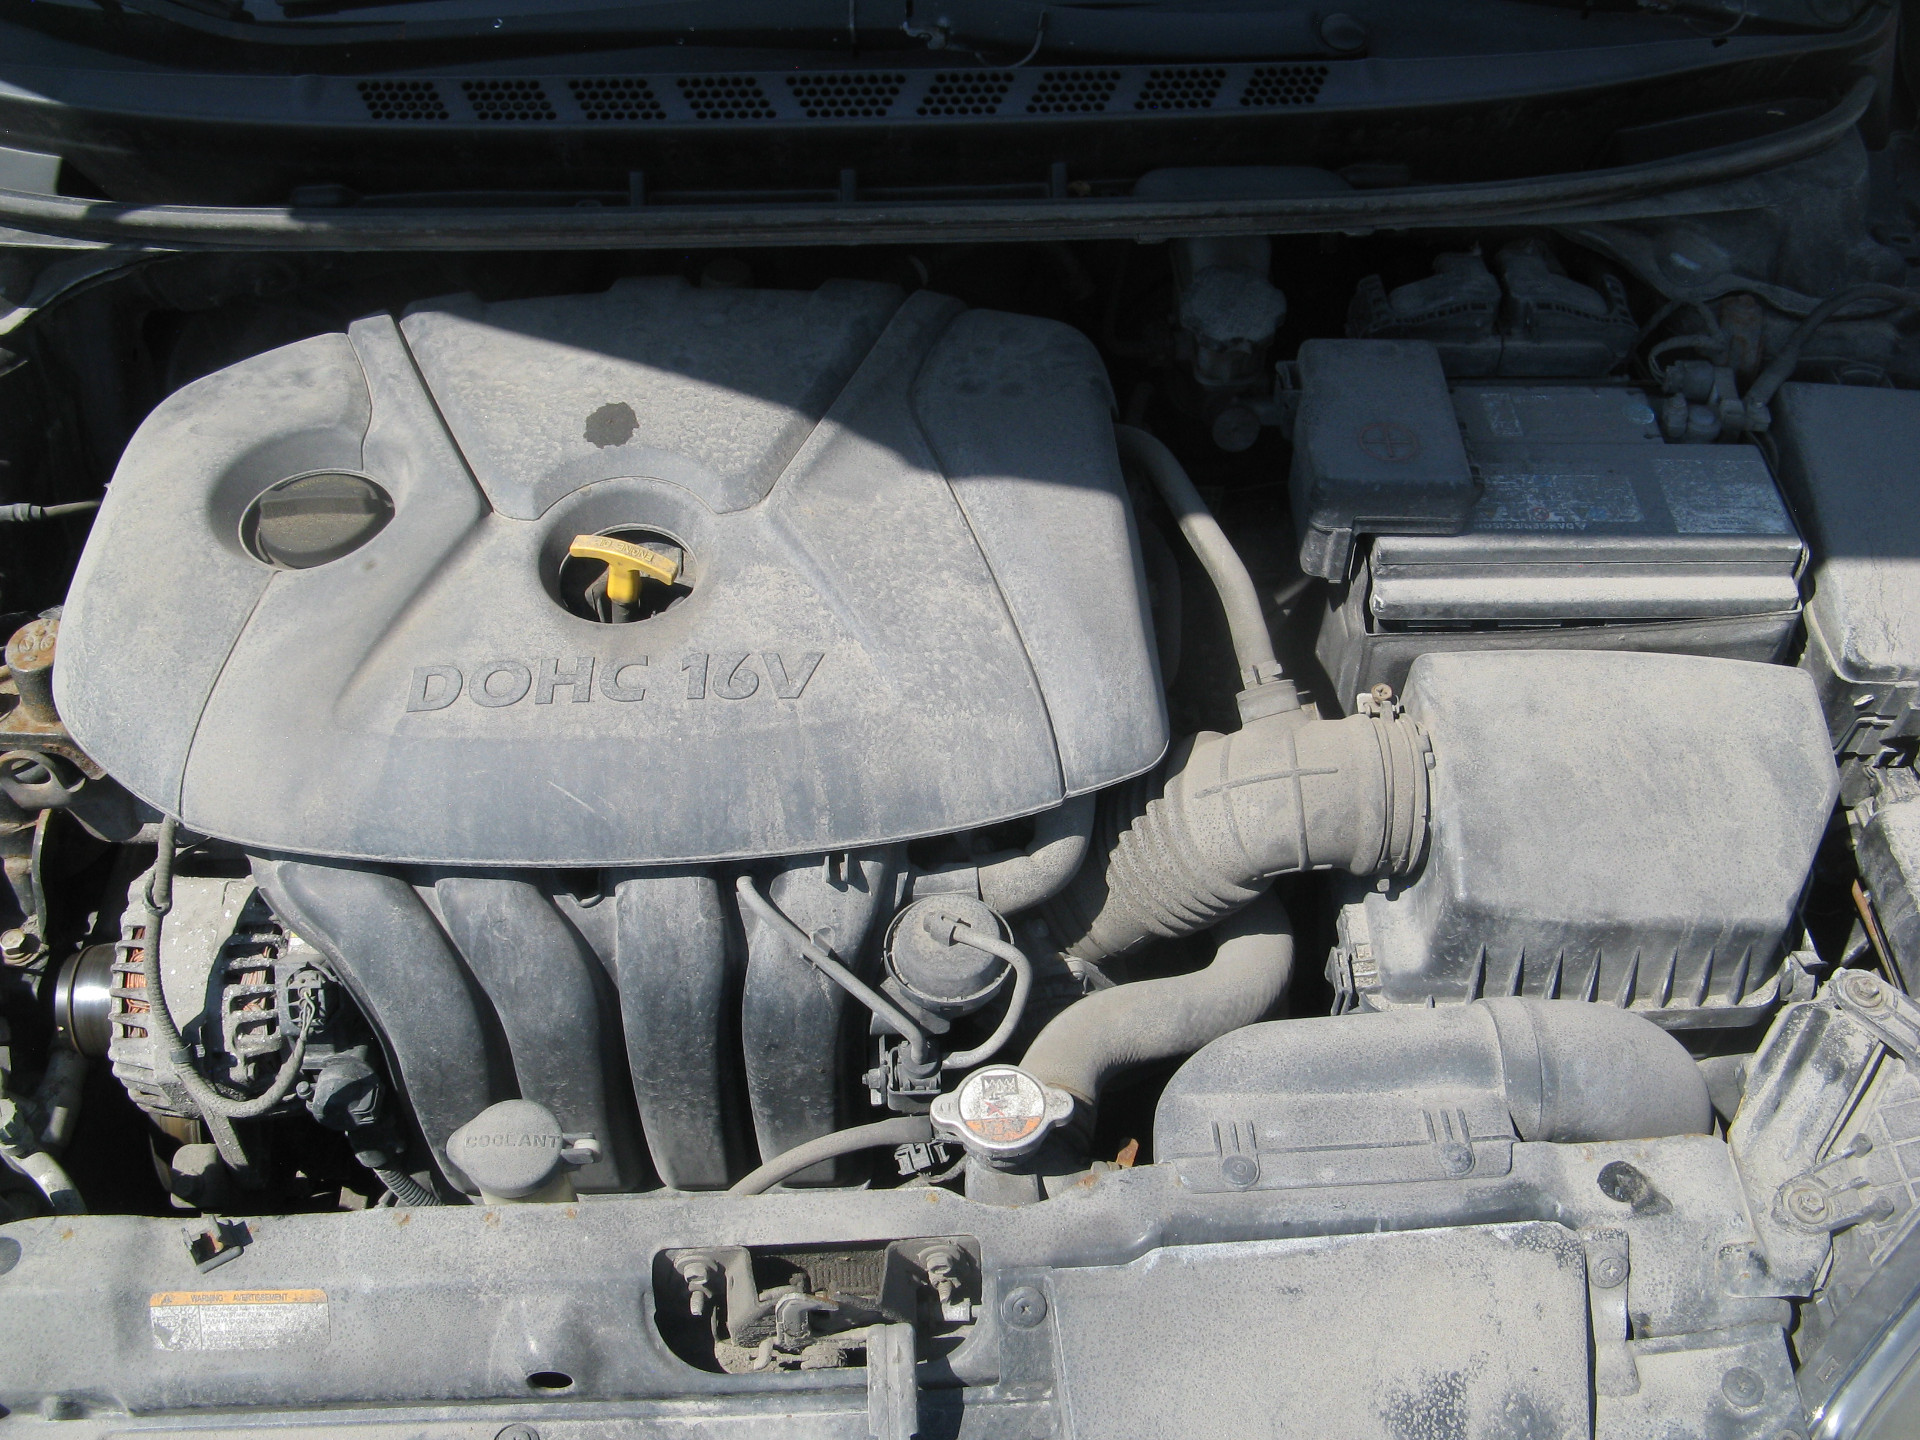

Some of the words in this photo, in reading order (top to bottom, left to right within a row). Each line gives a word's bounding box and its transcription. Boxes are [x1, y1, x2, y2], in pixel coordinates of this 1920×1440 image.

[406, 655, 649, 713] DOHC
[680, 652, 826, 701] 16V
[465, 1133, 561, 1149] COOLANT
[190, 1294, 224, 1303] WARNING
[232, 1293, 289, 1302] AVERTISSEMENT
